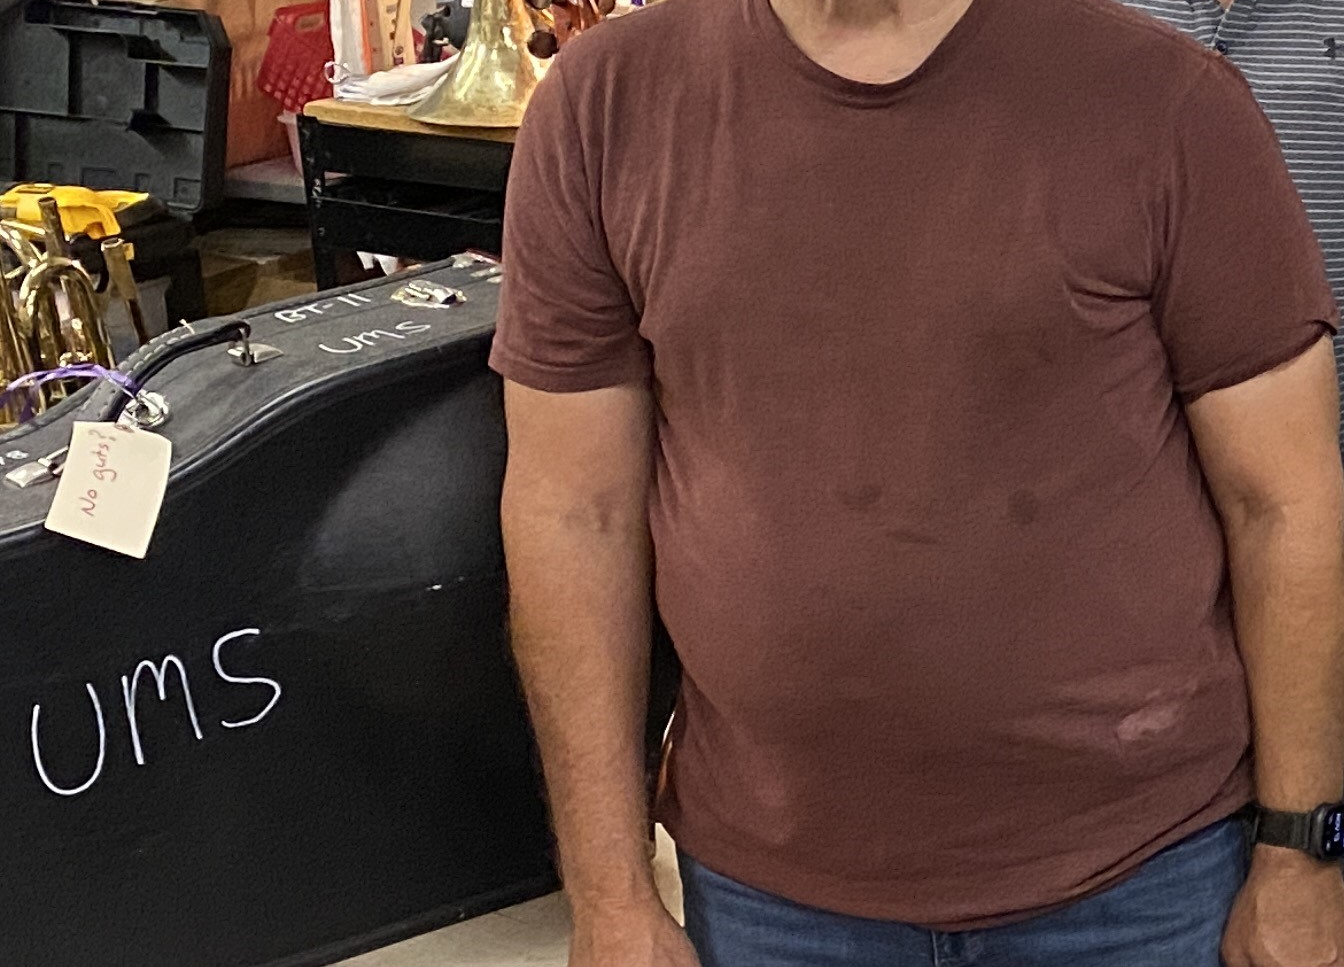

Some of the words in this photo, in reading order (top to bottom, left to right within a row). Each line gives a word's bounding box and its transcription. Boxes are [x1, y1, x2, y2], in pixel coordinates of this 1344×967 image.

[318, 321, 431, 354] UMS
[79, 489, 98, 517] No
[31, 628, 281, 795] UMS
